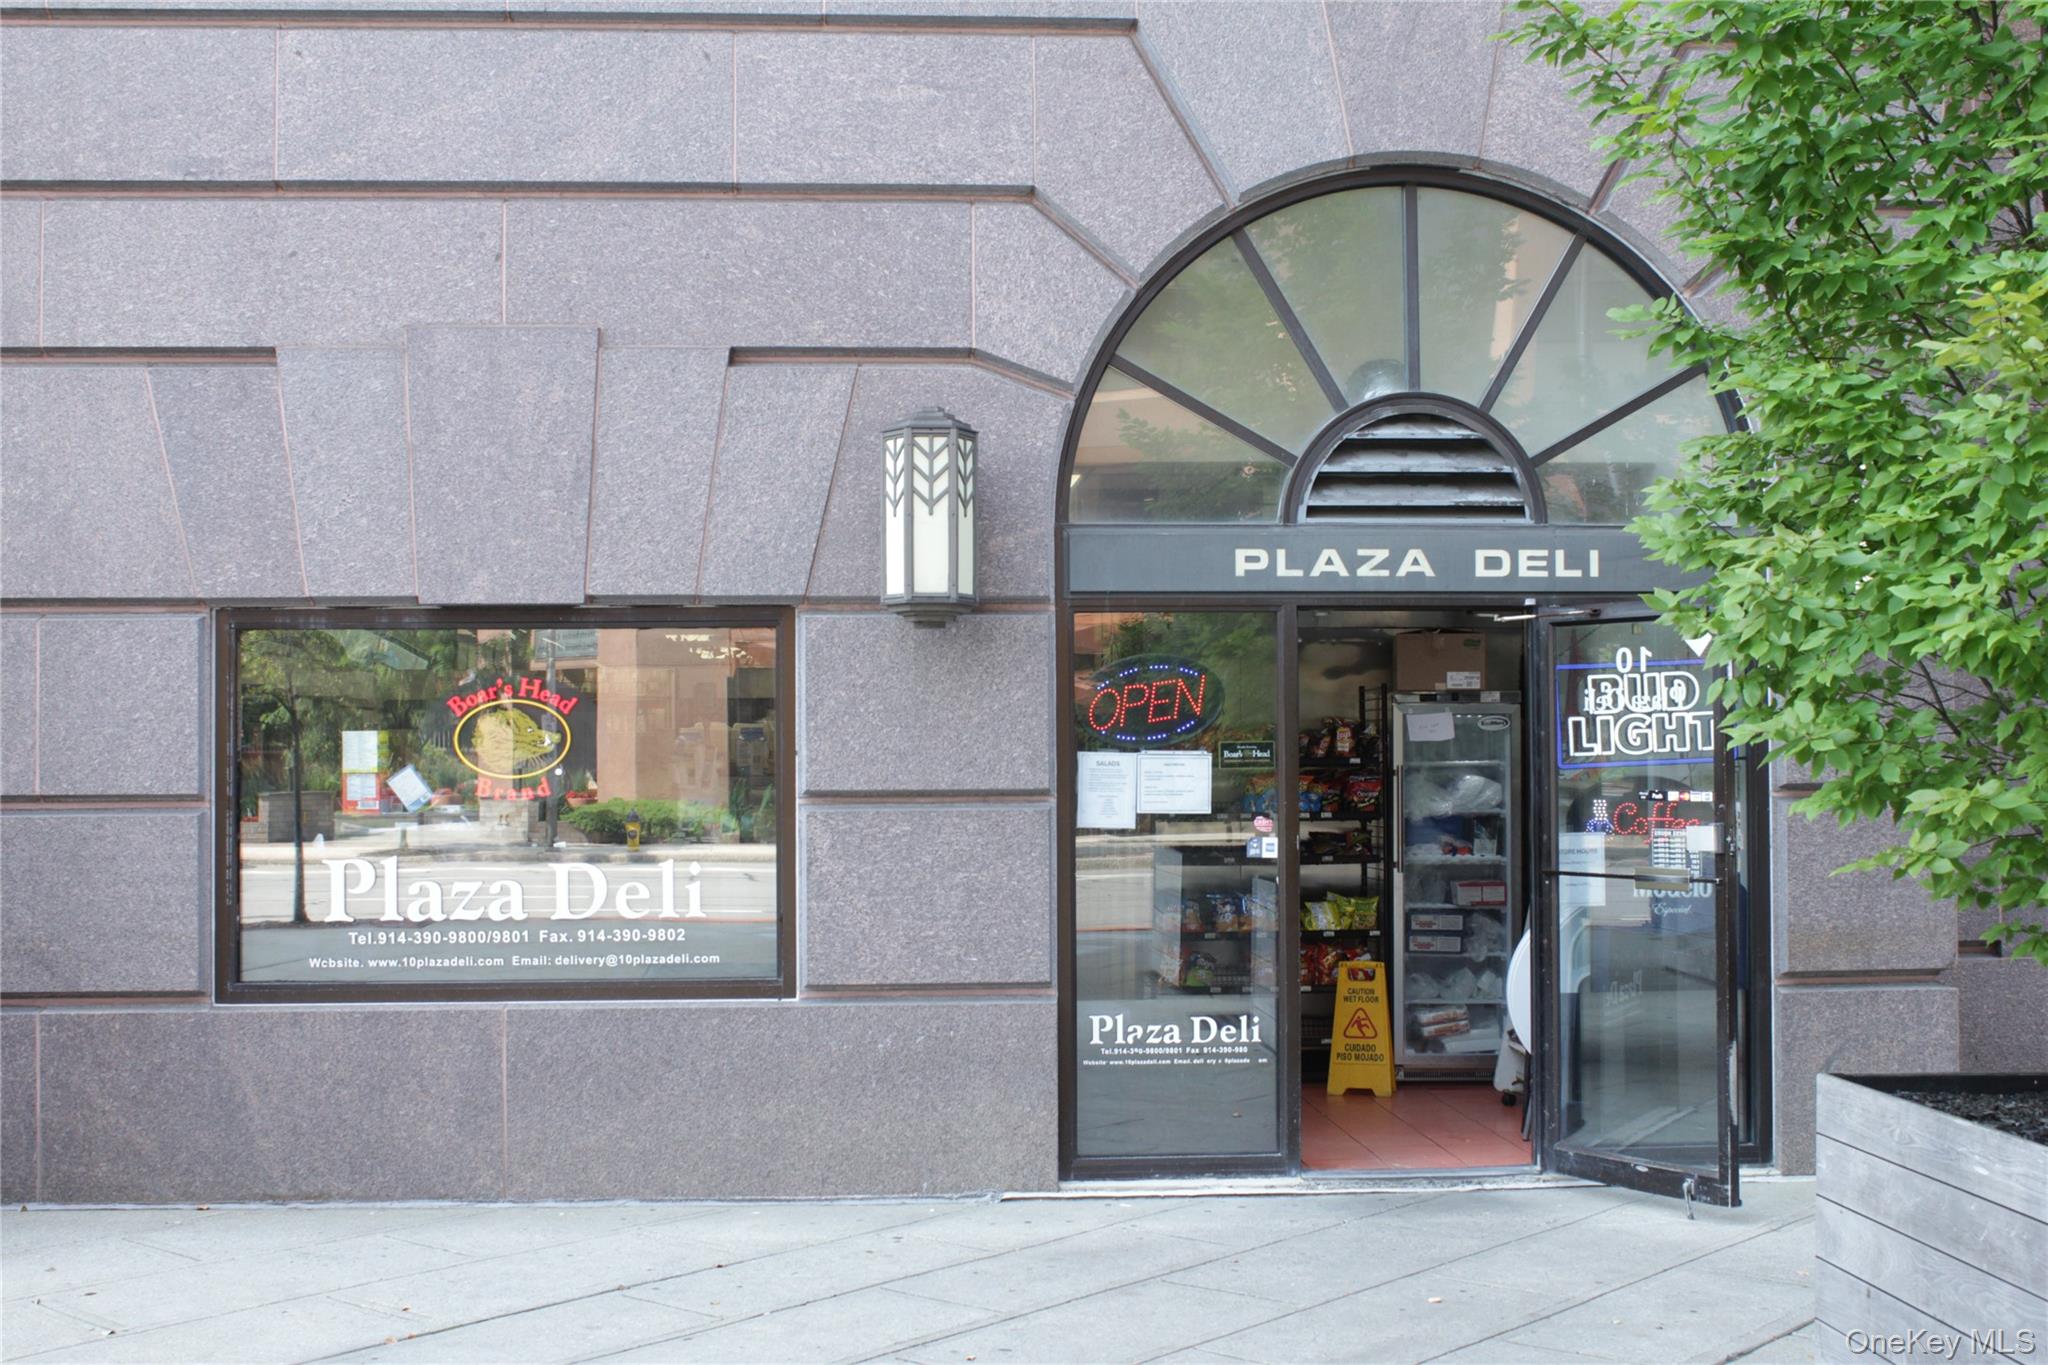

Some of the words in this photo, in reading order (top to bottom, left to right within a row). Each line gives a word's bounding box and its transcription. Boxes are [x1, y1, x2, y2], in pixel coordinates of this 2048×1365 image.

[1235, 549, 1436, 577] PLAZA
[1474, 549, 1600, 578] DELI
[446, 677, 514, 718] Boar's
[518, 676, 579, 716] Head
[1088, 673, 1207, 732] OPEN
[1586, 670, 1700, 715] BUD
[1568, 710, 1714, 757] LIGHT
[475, 776, 552, 801] Brand
[322, 855, 529, 923] Plaza
[547, 858, 708, 921] Deli
[348, 930, 530, 945] Tel.914-390-9800/9801
[539, 929, 573, 943] Fax.
[577, 928, 686, 943] 914-390-9802
[368, 955, 505, 970] www.10plazadeli.com
[554, 953, 721, 968] delivery@10plazadeli.com
[1343, 995, 1357, 1003] WET
[1358, 995, 1380, 1003] FLOOR
[1088, 1013, 1183, 1045] Plaza
[1190, 1014, 1263, 1044] Deli
[1336, 1052, 1353, 1061] PISO
[1354, 1053, 1385, 1062] MOJADO
[1344, 1043, 1377, 1052] CUIDADO
